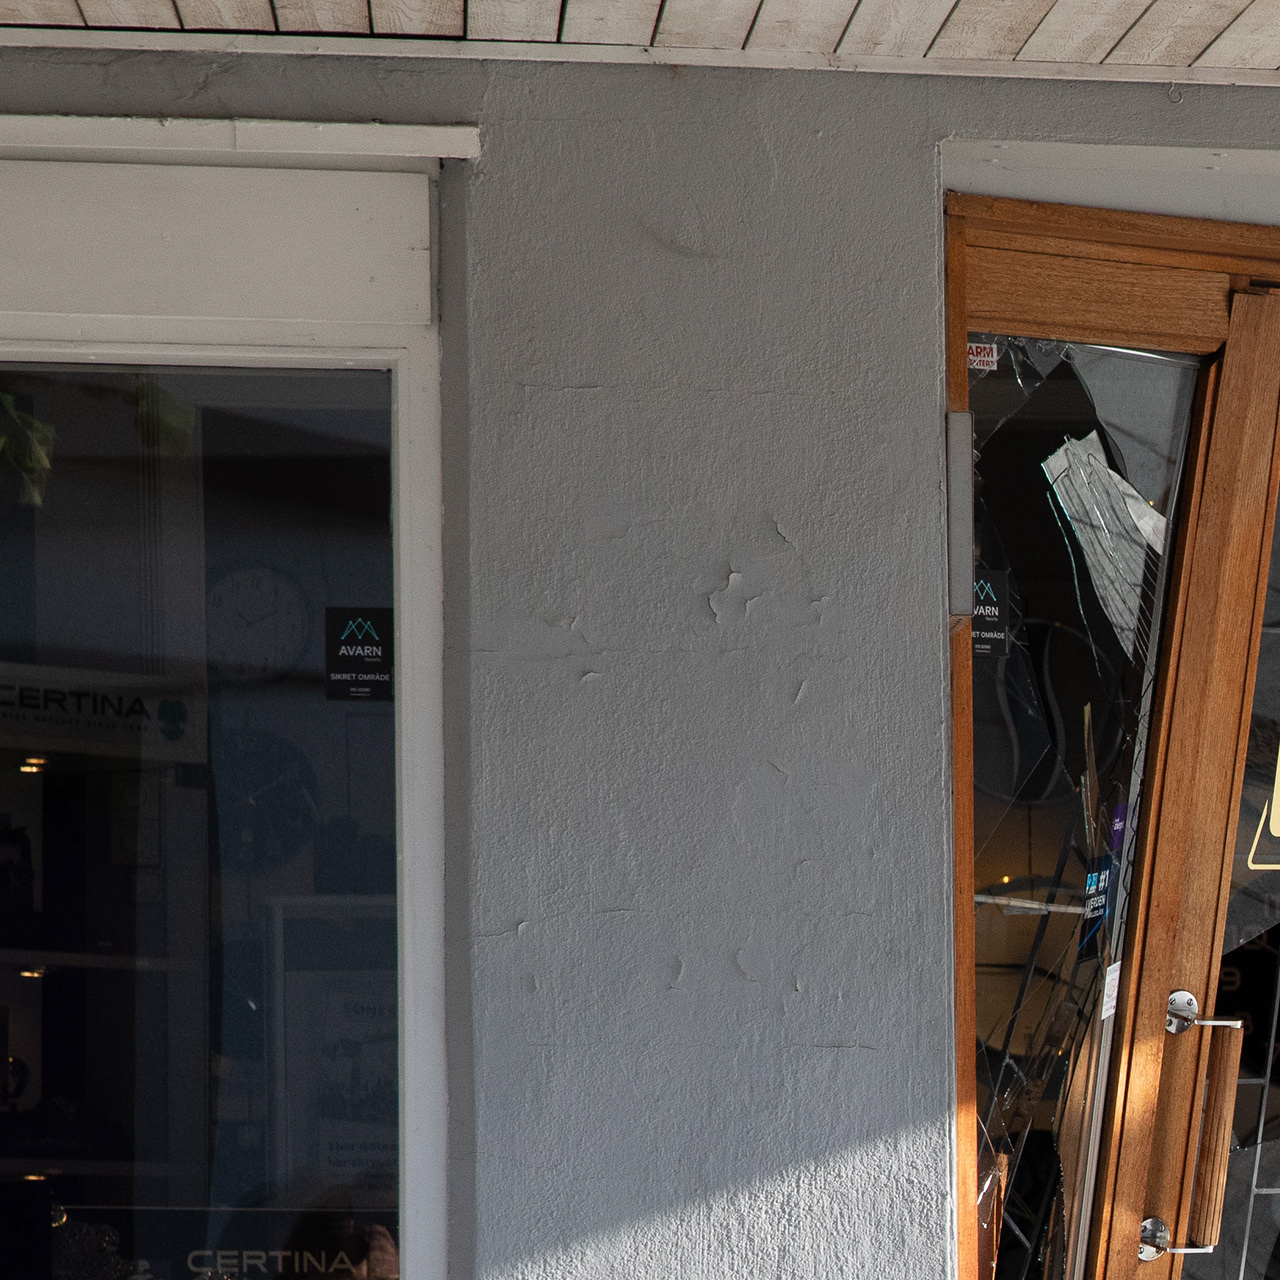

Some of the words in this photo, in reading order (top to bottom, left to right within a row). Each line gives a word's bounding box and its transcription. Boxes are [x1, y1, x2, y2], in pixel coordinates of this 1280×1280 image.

[981, 630, 1005, 640] OMRÅDE
[339, 645, 382, 656] AVARN
[358, 671, 390, 681] OMRÅDE
[187, 1250, 356, 1273] CERTINA
